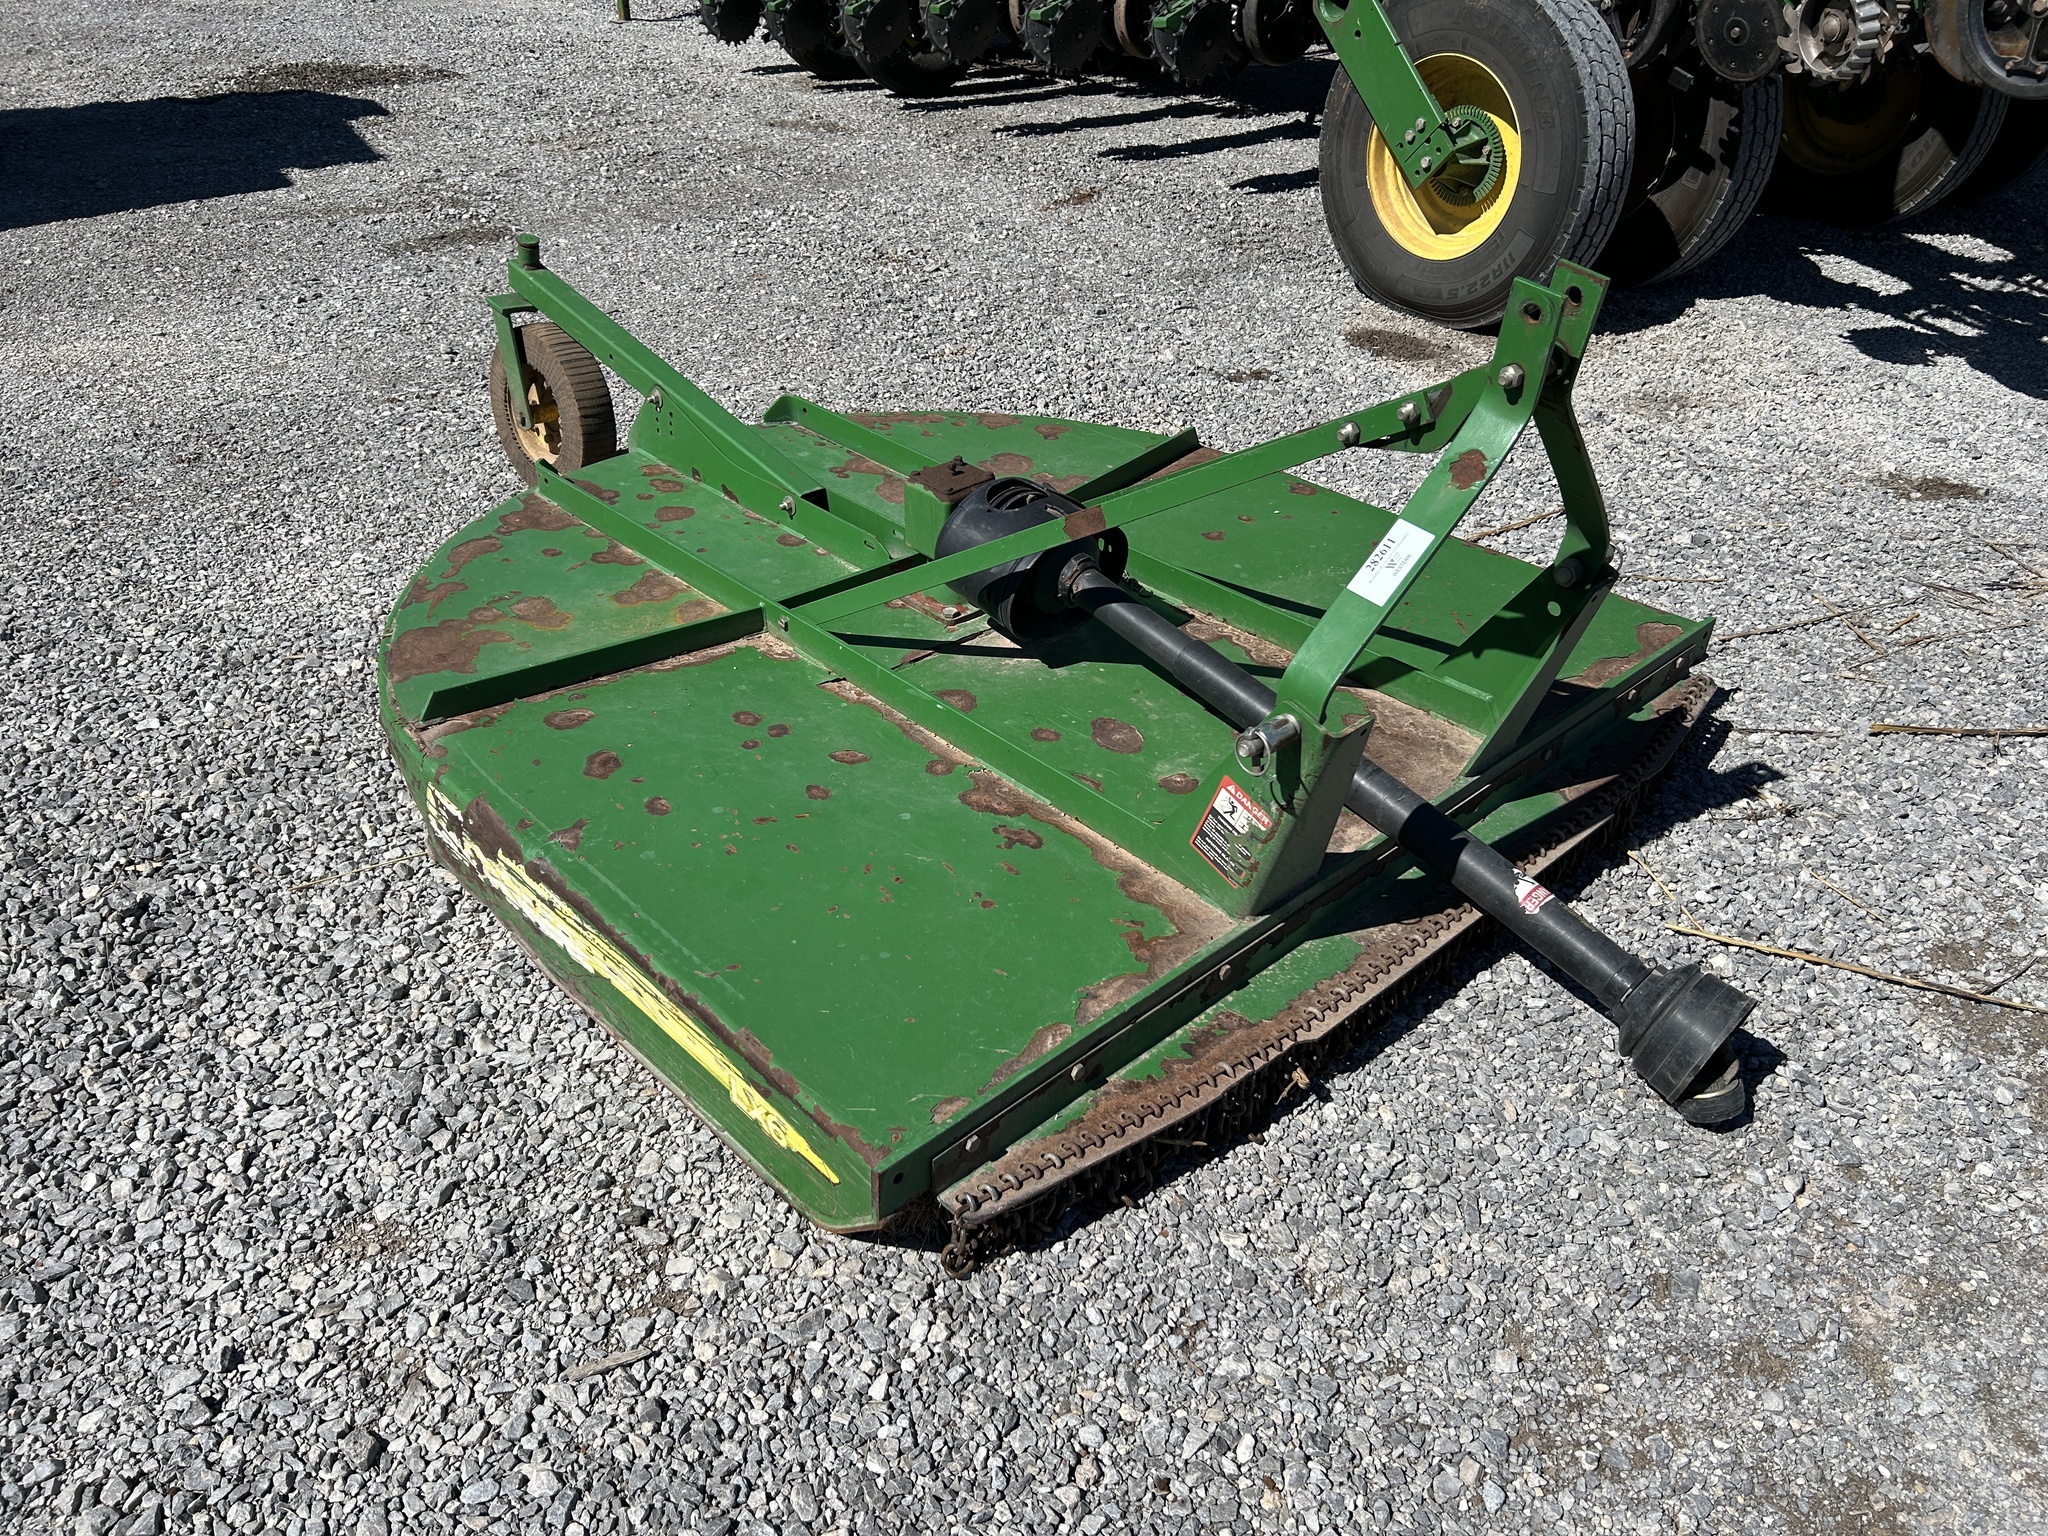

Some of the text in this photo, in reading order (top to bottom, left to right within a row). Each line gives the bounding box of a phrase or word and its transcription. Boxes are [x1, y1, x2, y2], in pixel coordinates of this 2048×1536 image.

[1452, 6, 1556, 131] FORTUNE
[1446, 251, 1516, 300] 11R22.5
[1365, 538, 1397, 572] 282611
[1392, 554, 1412, 577] WESTERN
[1236, 791, 1270, 825] DANGER
